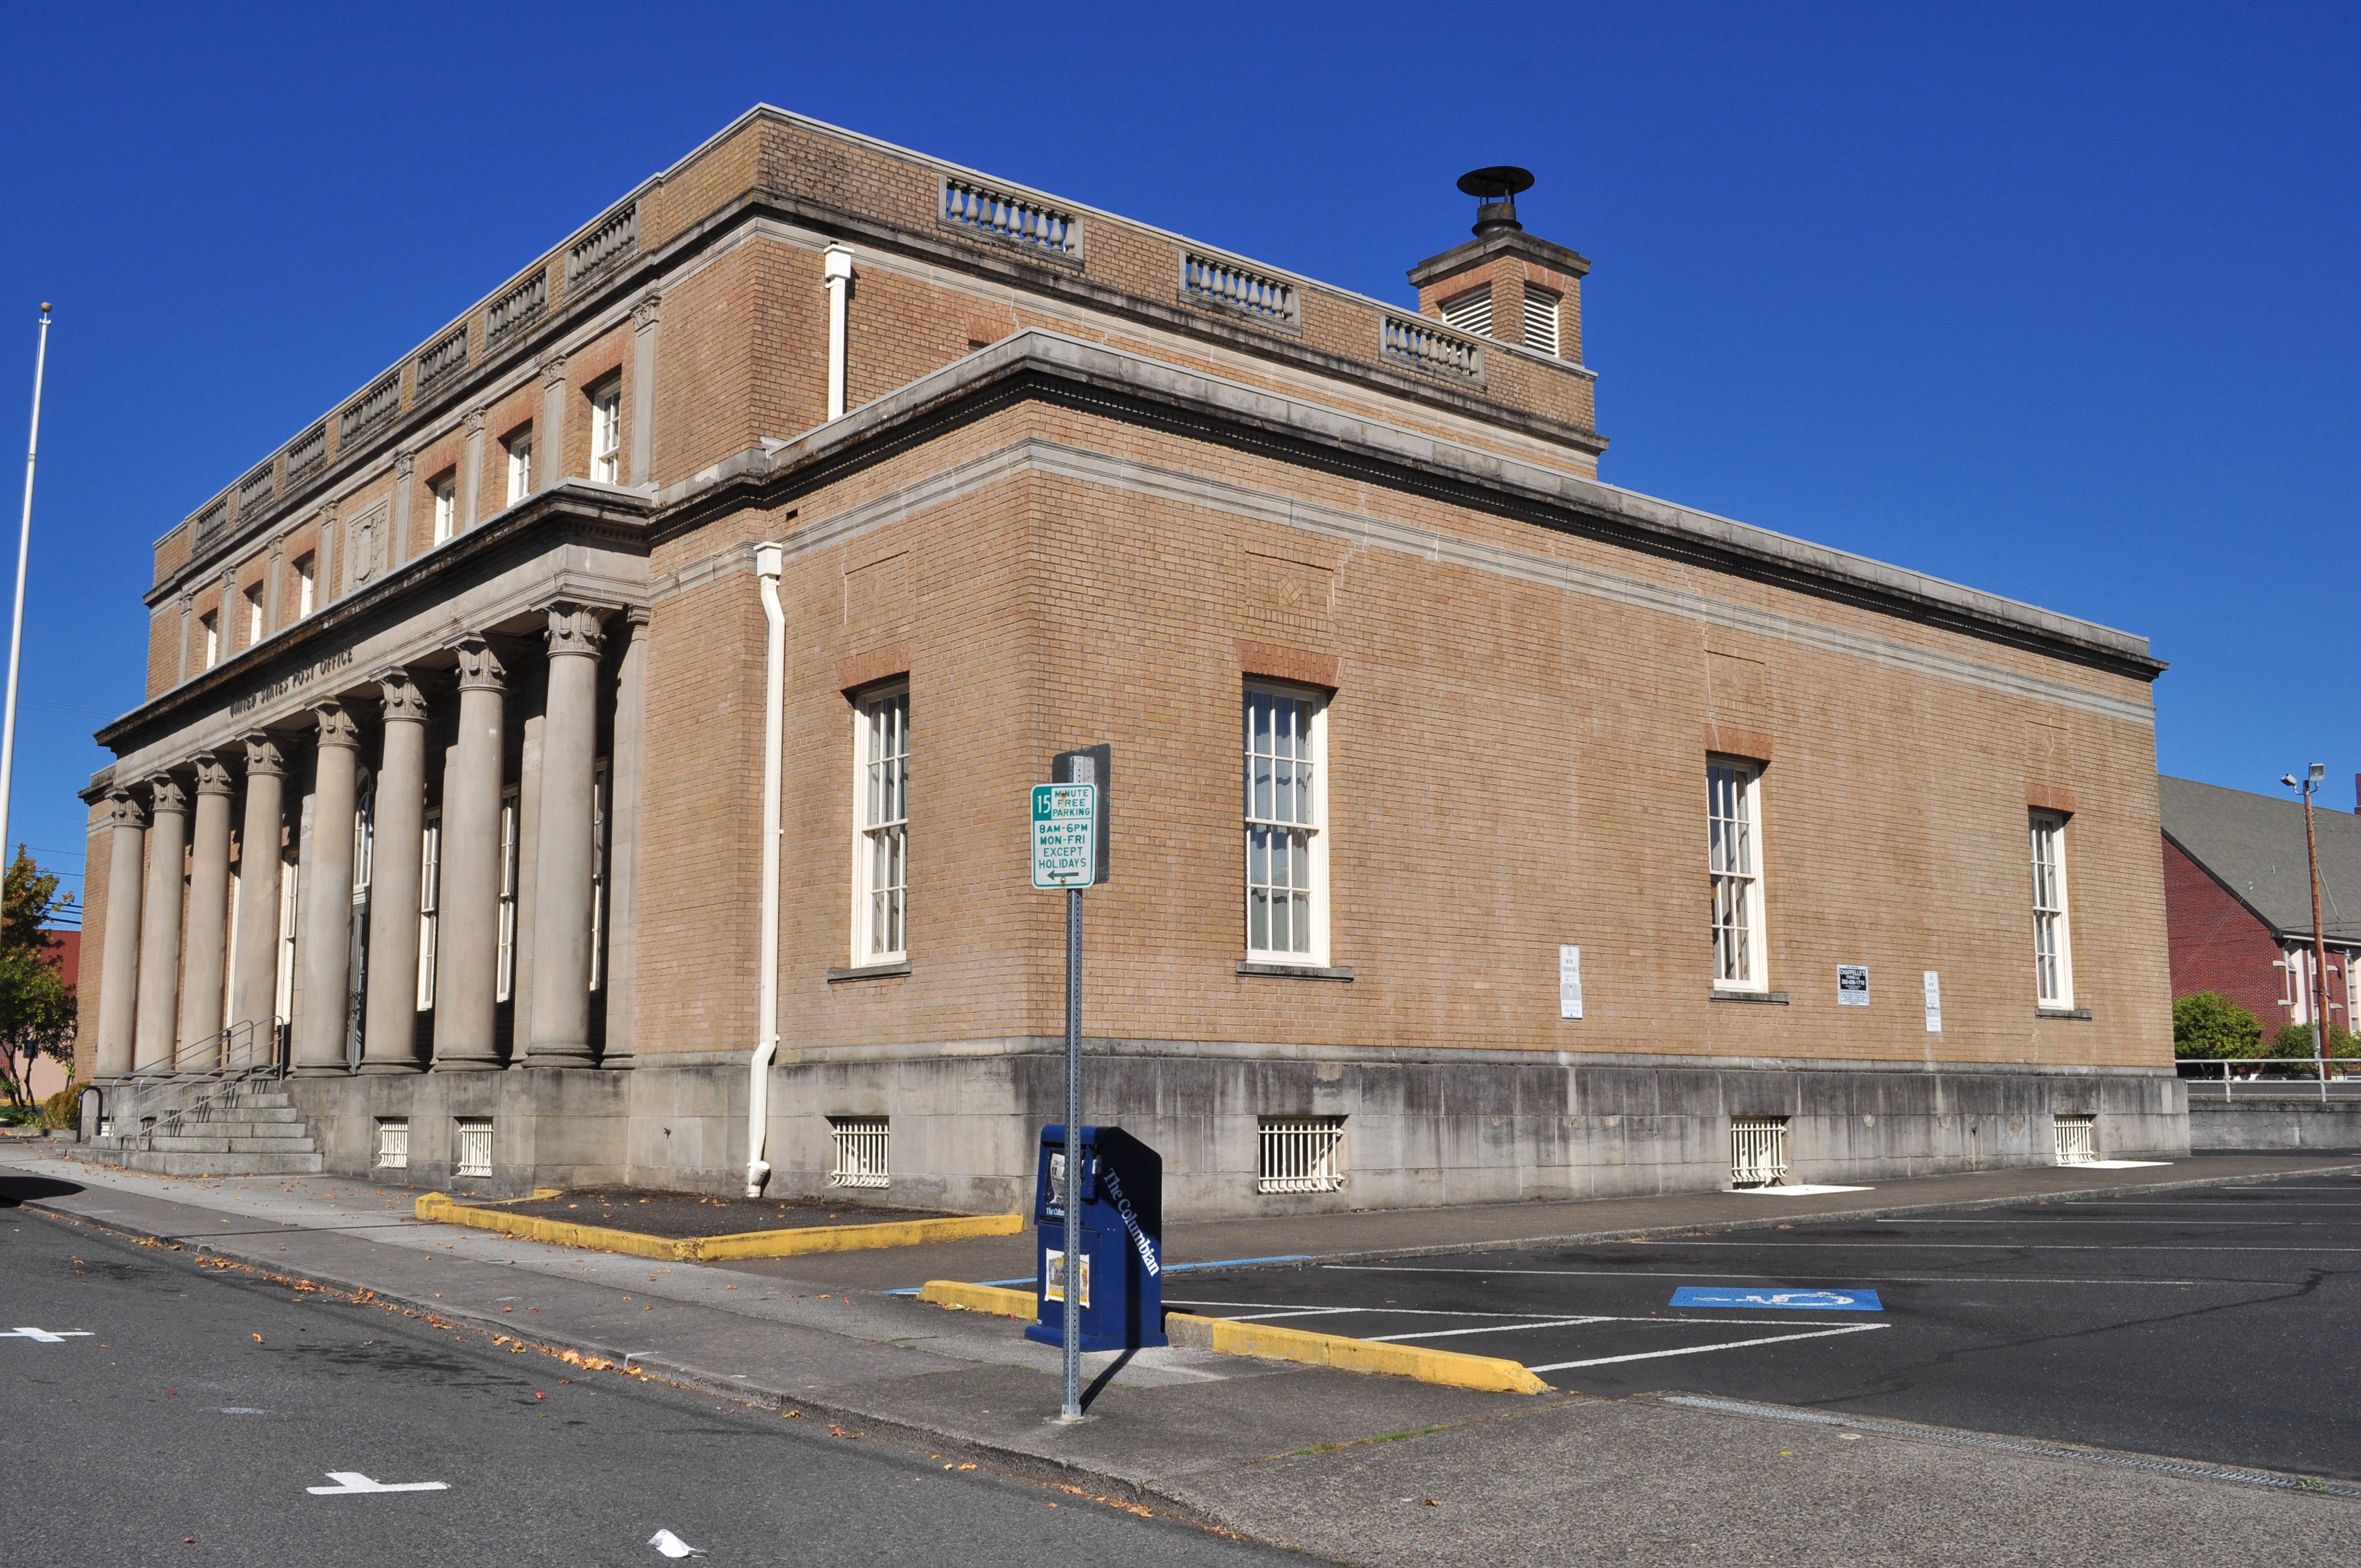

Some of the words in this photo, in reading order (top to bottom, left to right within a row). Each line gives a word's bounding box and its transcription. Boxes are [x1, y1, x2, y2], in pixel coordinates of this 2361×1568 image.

[260, 676, 289, 704] STATES
[292, 663, 315, 688] POST
[319, 645, 354, 676] OFFICE
[1054, 790, 1089, 798] MNUTE
[1037, 794, 1051, 813] 15
[1052, 808, 1090, 816] PARKING
[1040, 835, 1085, 845] MON-FRI
[1043, 847, 1083, 857] EXCEPT
[1038, 858, 1086, 869] HOLIDAYS
[1104, 1168, 1123, 1200] The
[1118, 1199, 1160, 1277] Columbian
